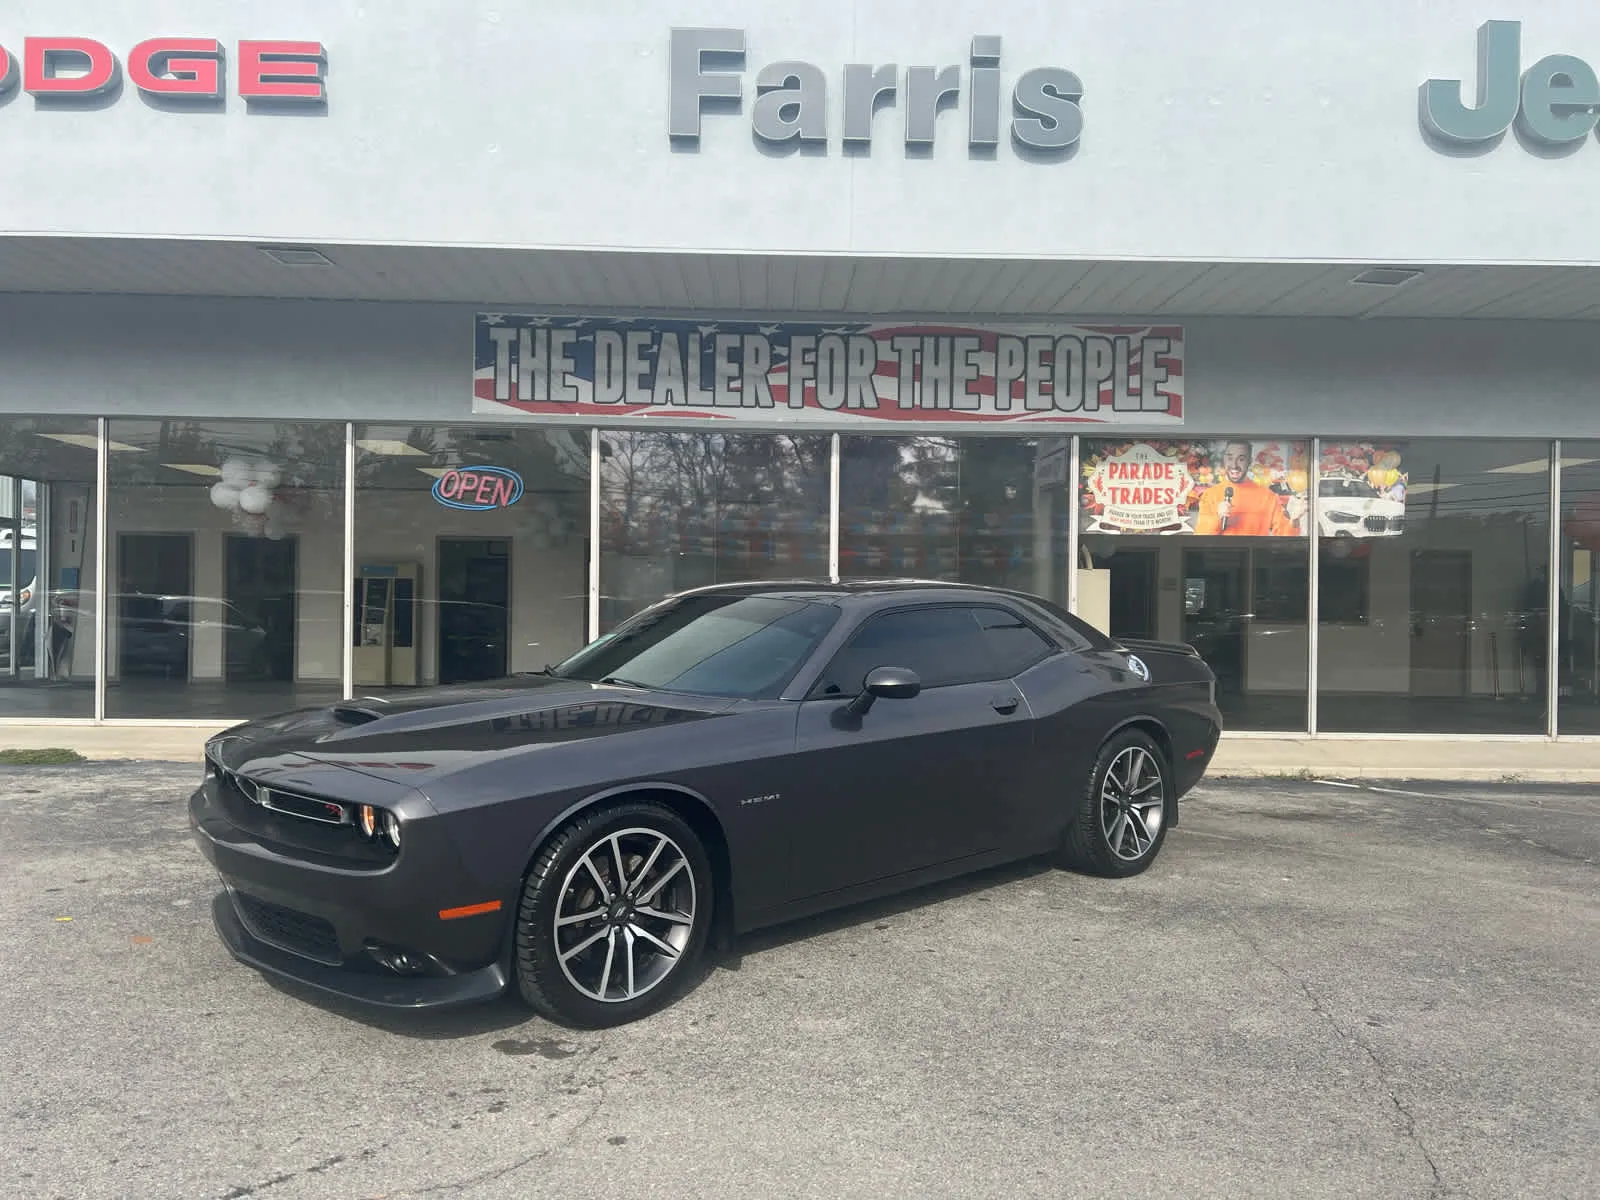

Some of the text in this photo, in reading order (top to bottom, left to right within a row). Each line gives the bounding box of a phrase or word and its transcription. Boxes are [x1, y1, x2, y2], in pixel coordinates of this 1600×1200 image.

[0, 37, 327, 104] DGE
[669, 27, 1084, 152] Farris
[1418, 20, 1600, 150] Je
[489, 327, 1172, 412] THE DEALER FOR THE PEOPLE
[440, 470, 514, 507] OPEN
[1108, 462, 1175, 480] PARADE
[1108, 487, 1175, 505] TRADES
